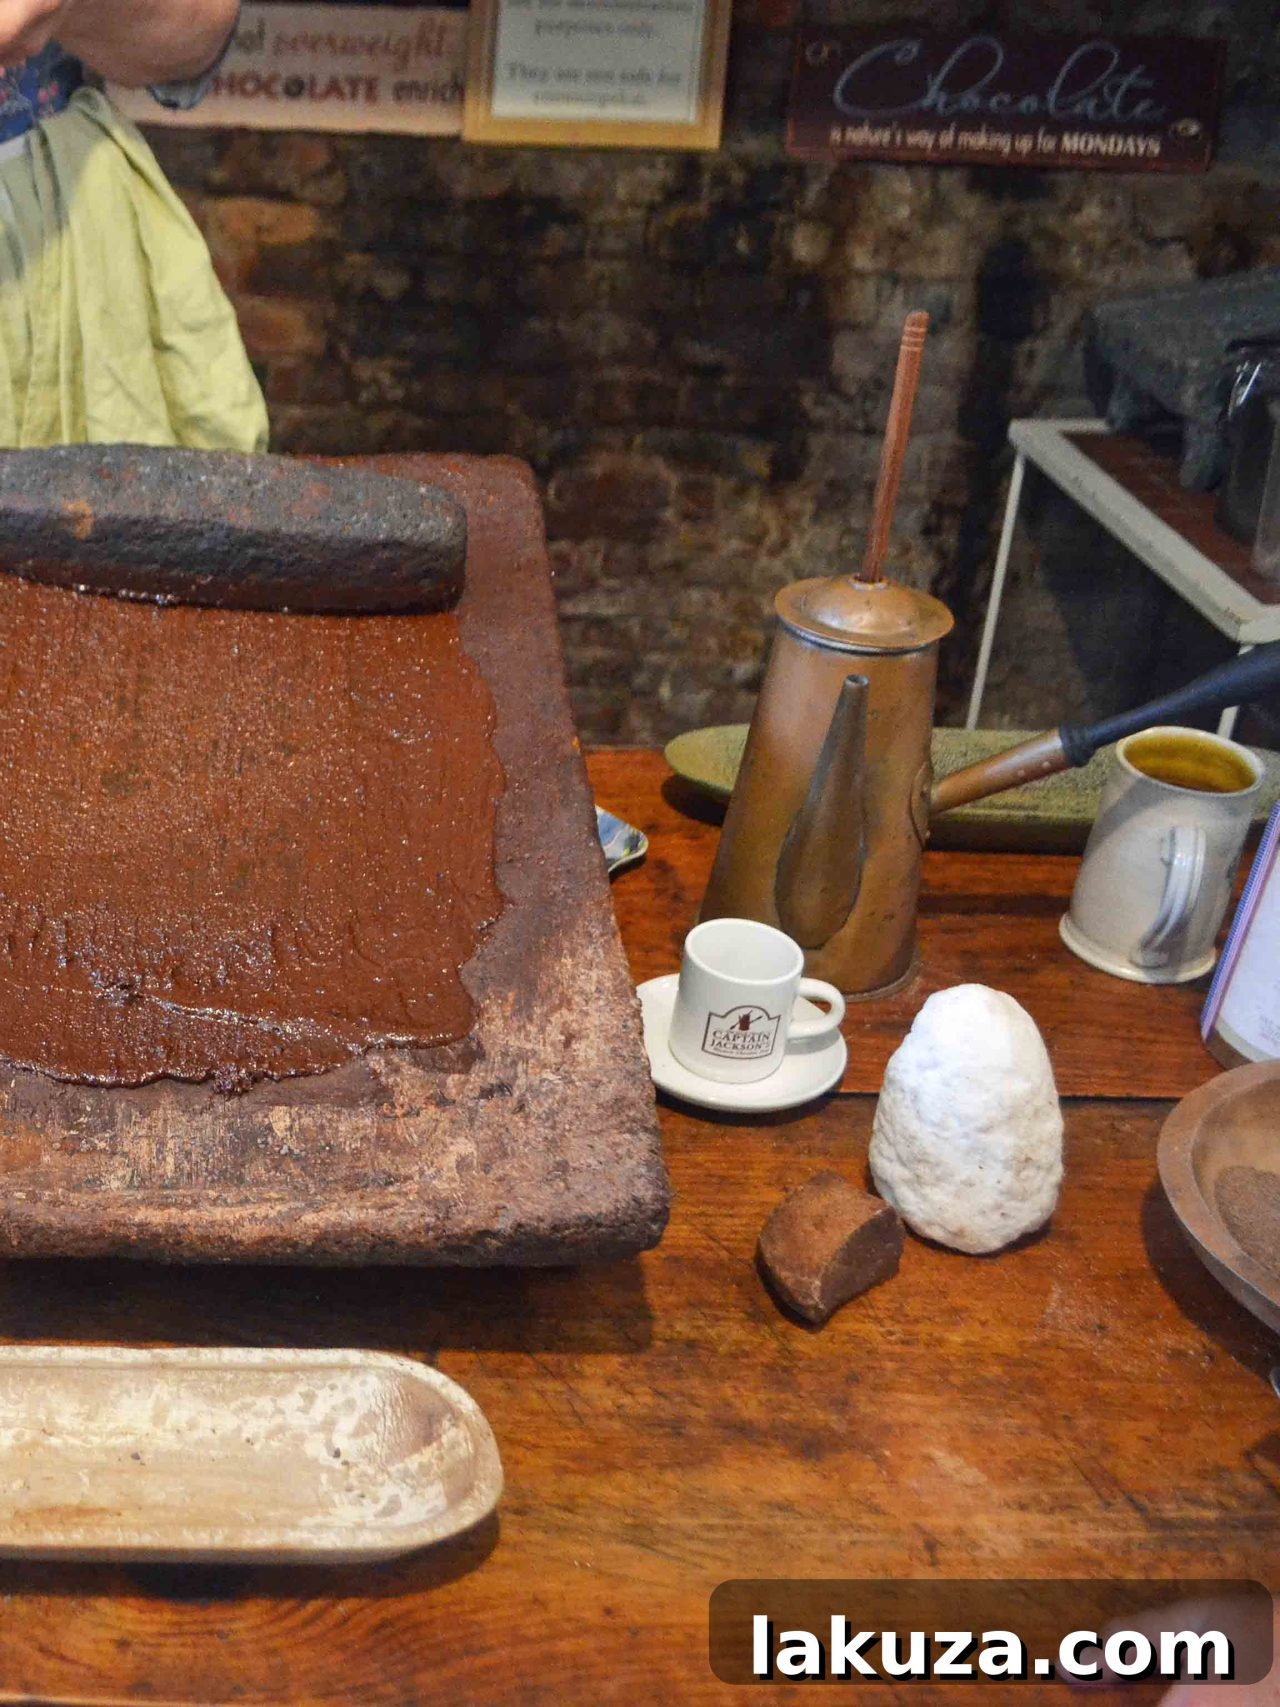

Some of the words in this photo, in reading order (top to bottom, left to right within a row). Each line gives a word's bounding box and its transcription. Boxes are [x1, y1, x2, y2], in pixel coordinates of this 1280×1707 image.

[208, 69, 381, 102] HOCOLATE
[833, 33, 1166, 121] Chocolate
[1061, 130, 1162, 157] MONDAYS
[712, 1029, 771, 1043] CAPTAIN
